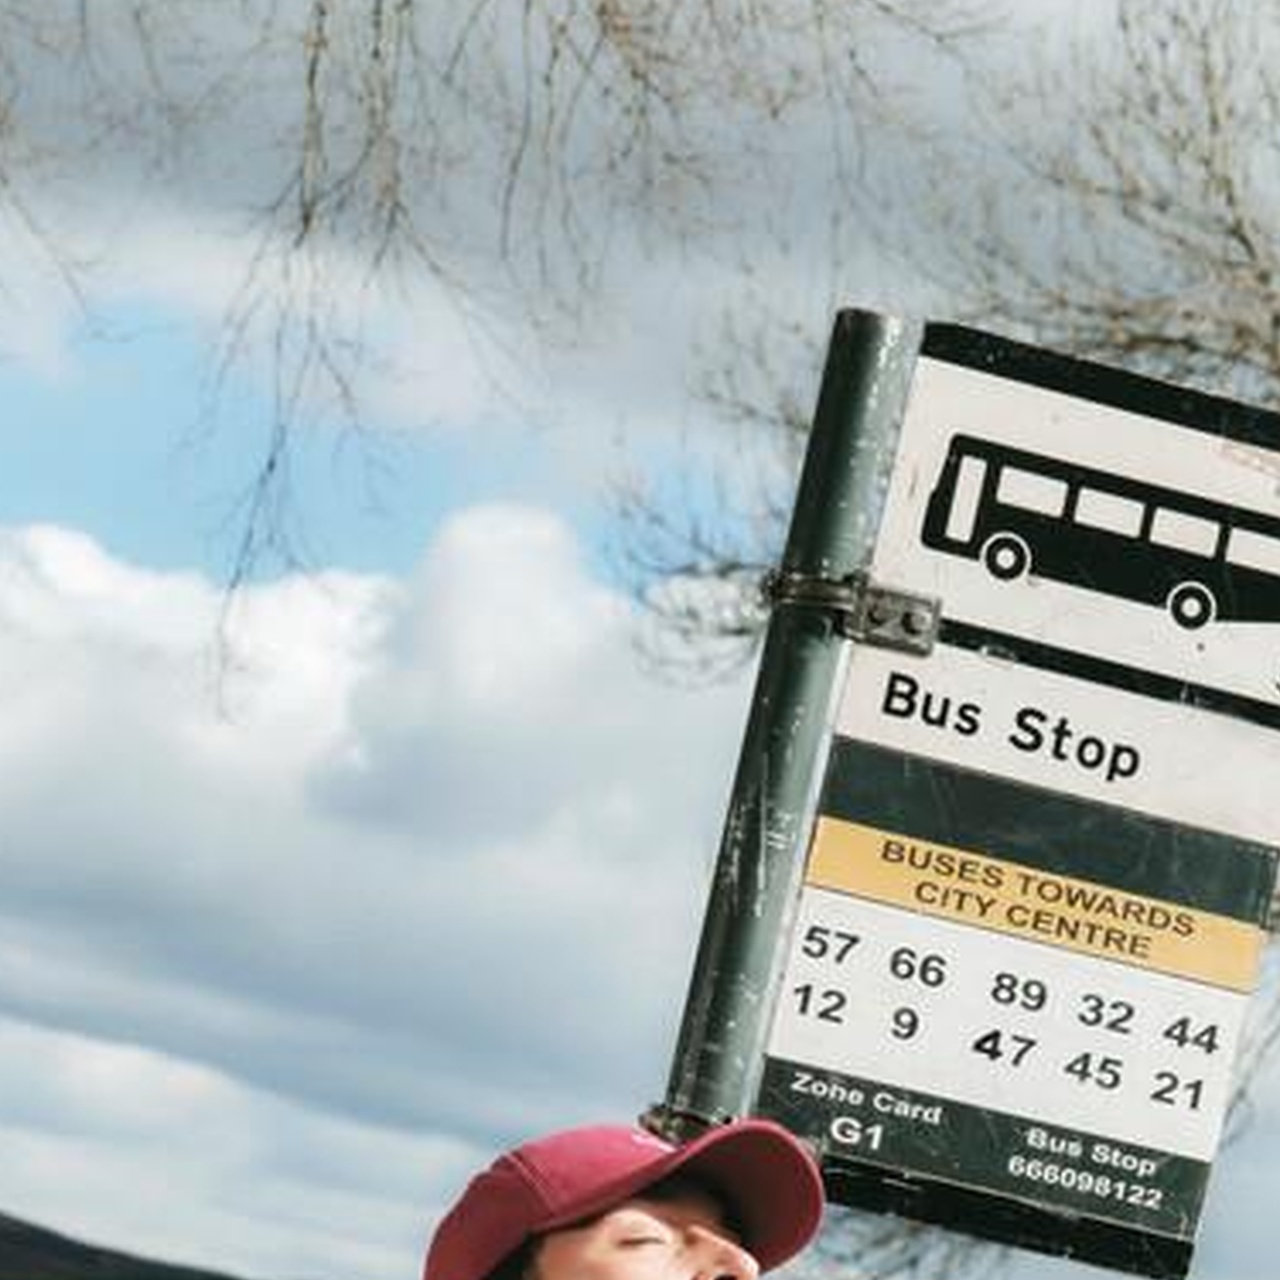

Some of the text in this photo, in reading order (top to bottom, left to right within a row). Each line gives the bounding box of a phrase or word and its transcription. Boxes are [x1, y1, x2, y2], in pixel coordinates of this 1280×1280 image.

[882, 672, 1140, 782] Bus Stop
[881, 839, 1194, 937] BUSES TOWARDS
[915, 881, 1152, 959] CITY CENTRE
[802, 925, 1218, 1055] 57 66 89 32 44
[795, 985, 1203, 1110] 12 9 47 45 21
[791, 1072, 942, 1125] Zone Card
[830, 1116, 883, 1150] G1
[1008, 1155, 1163, 1210] 666098122
[1027, 1128, 1157, 1177] Bus Stop
